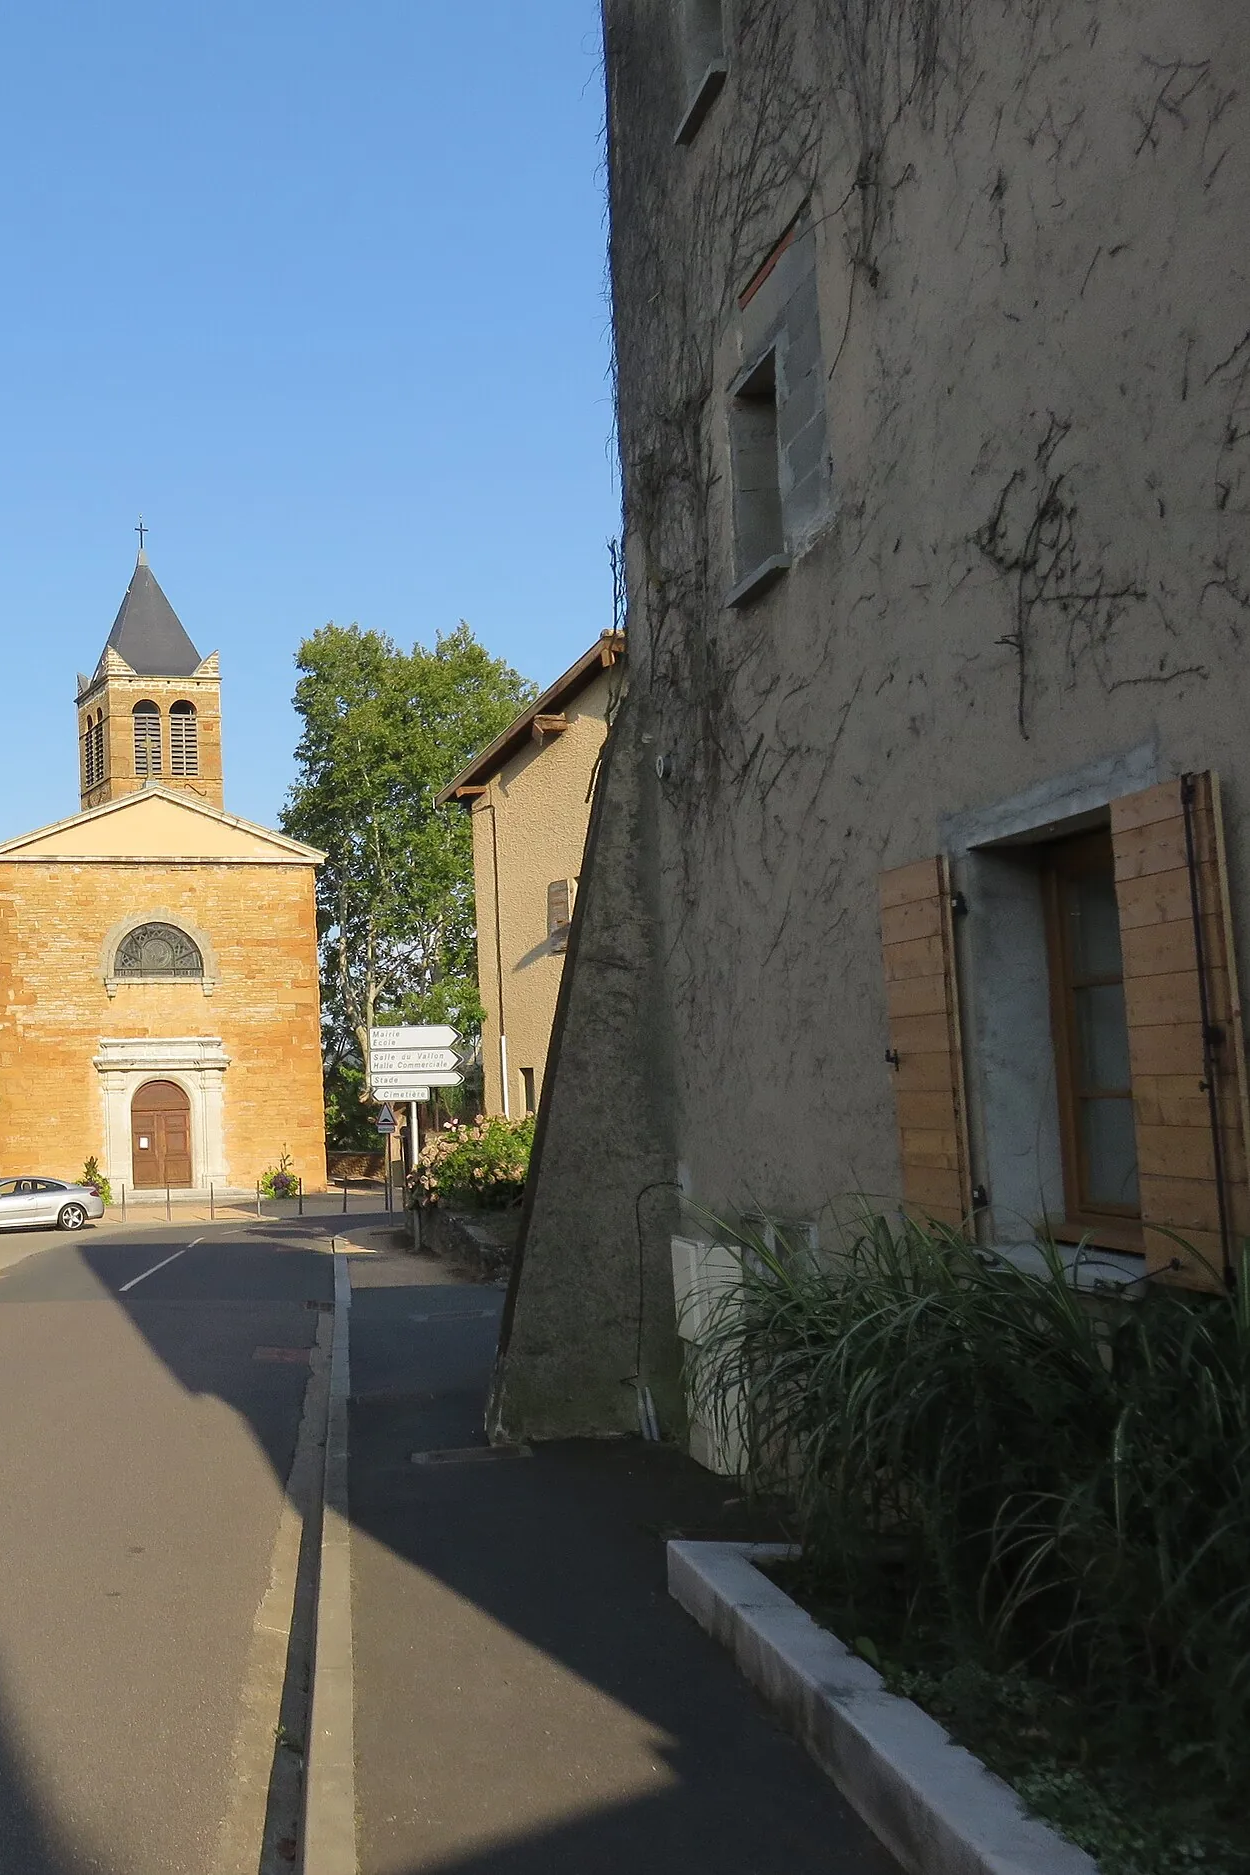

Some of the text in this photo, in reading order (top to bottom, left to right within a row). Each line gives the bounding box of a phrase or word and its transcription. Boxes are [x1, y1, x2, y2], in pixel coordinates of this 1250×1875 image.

[373, 1053, 396, 1061] Salle
[373, 1060, 448, 1070] Halle Commerciale
[374, 1076, 399, 1084] Stade
[383, 1090, 426, 1098] Cimetière
